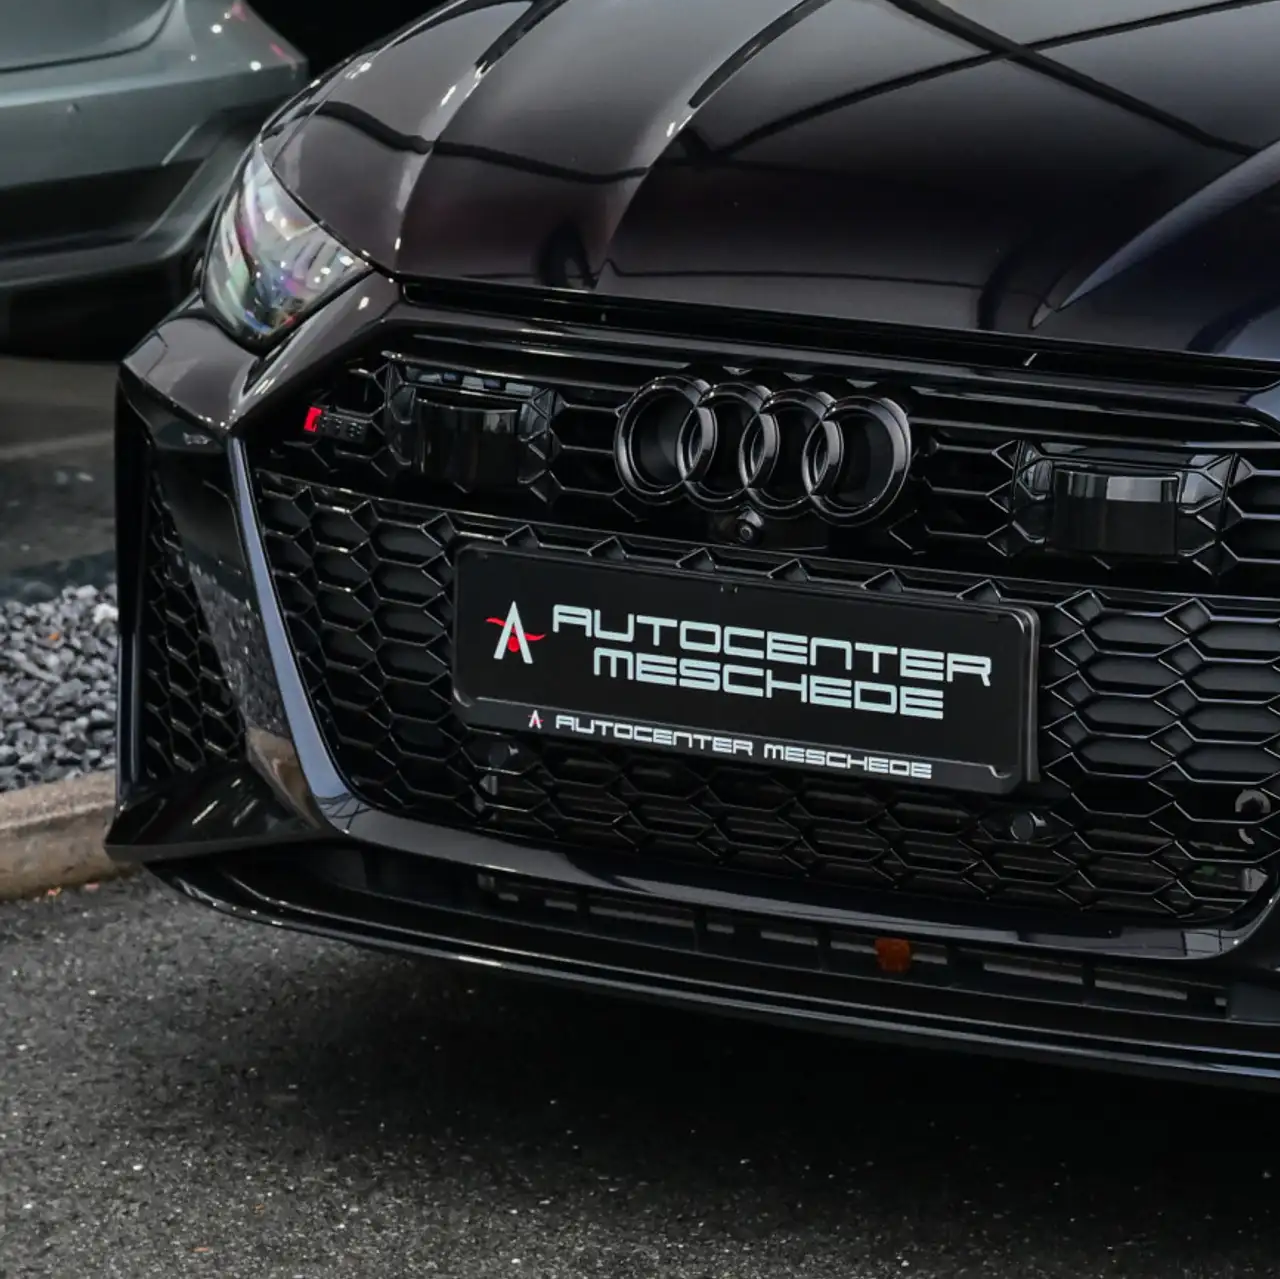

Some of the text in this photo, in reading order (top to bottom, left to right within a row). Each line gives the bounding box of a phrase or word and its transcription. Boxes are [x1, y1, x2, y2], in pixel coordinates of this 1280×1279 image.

[553, 605, 991, 686] AUTOCENTER
[594, 648, 943, 719] MESCHEDE
[556, 715, 932, 779] AUTOCENTER MESCHEDE
